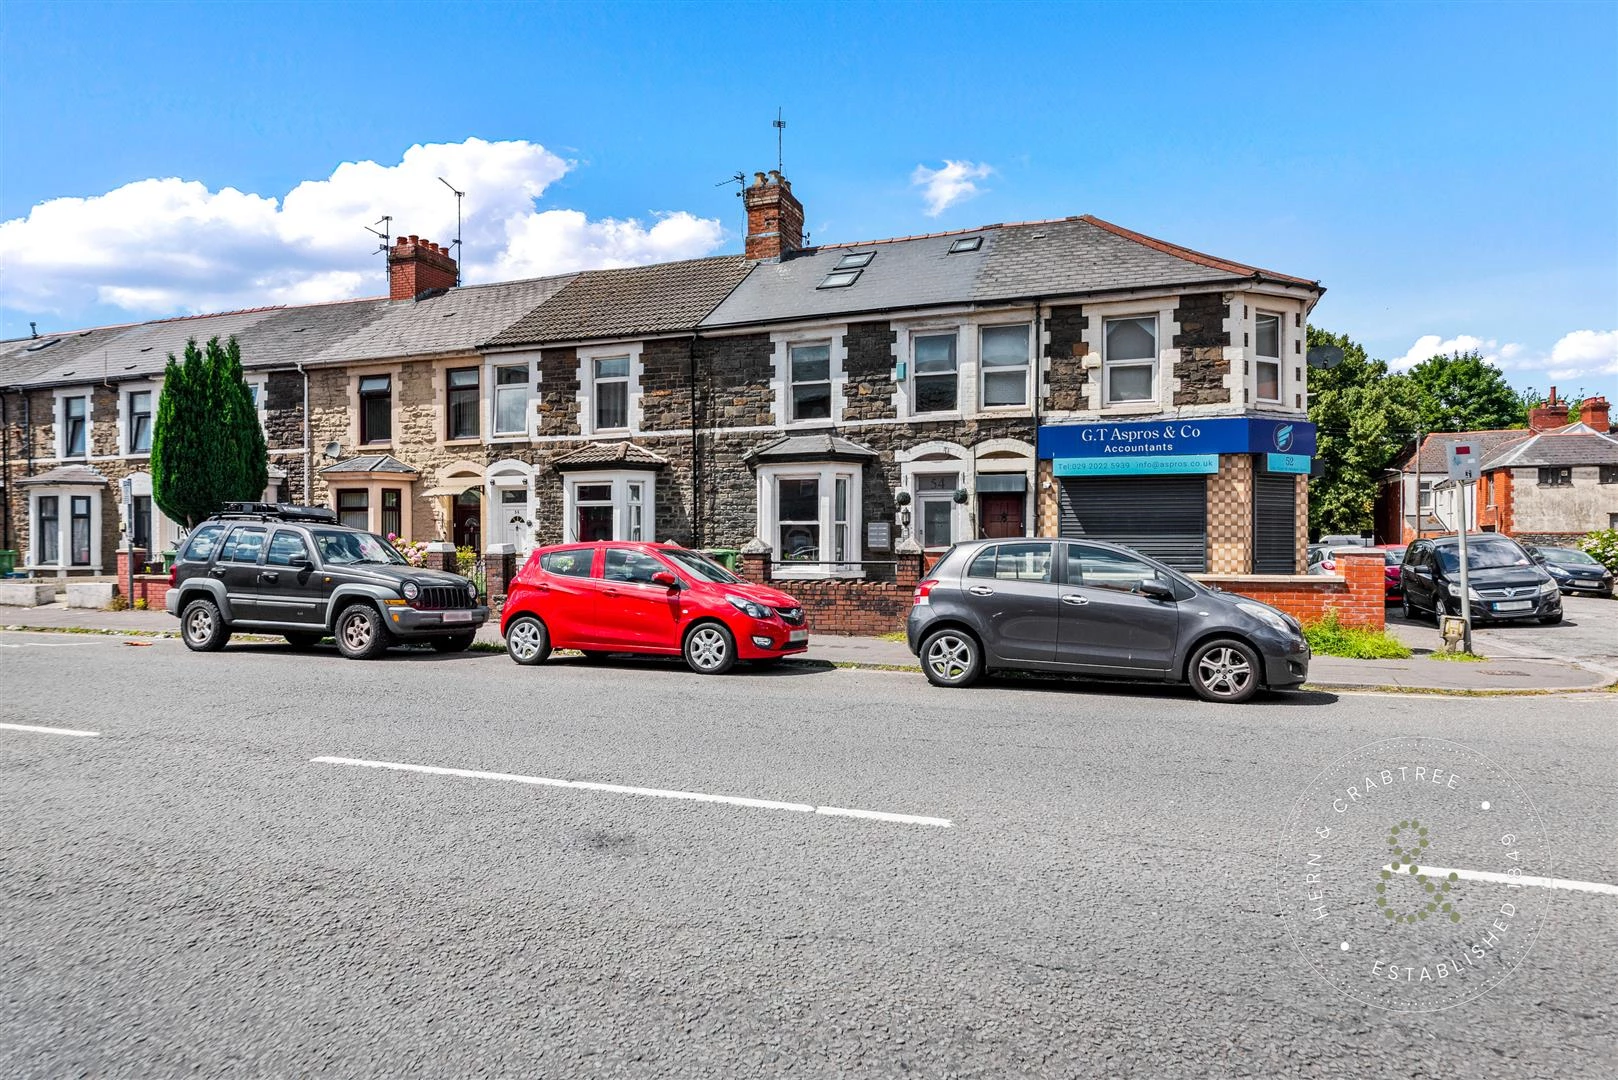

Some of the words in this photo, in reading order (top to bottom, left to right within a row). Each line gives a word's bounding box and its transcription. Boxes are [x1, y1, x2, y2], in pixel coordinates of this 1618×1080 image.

[1081, 427, 1109, 442] G.T
[1110, 426, 1160, 443] Aspros
[1163, 425, 1176, 439] &
[1180, 424, 1201, 438] Co
[1104, 443, 1174, 453] Accountants
[1088, 462, 1108, 470] 2022
[1110, 461, 1130, 470] 5939
[1136, 459, 1213, 470] info@aspros.co.uk
[1285, 456, 1294, 466] 52
[930, 478, 944, 489] 54
